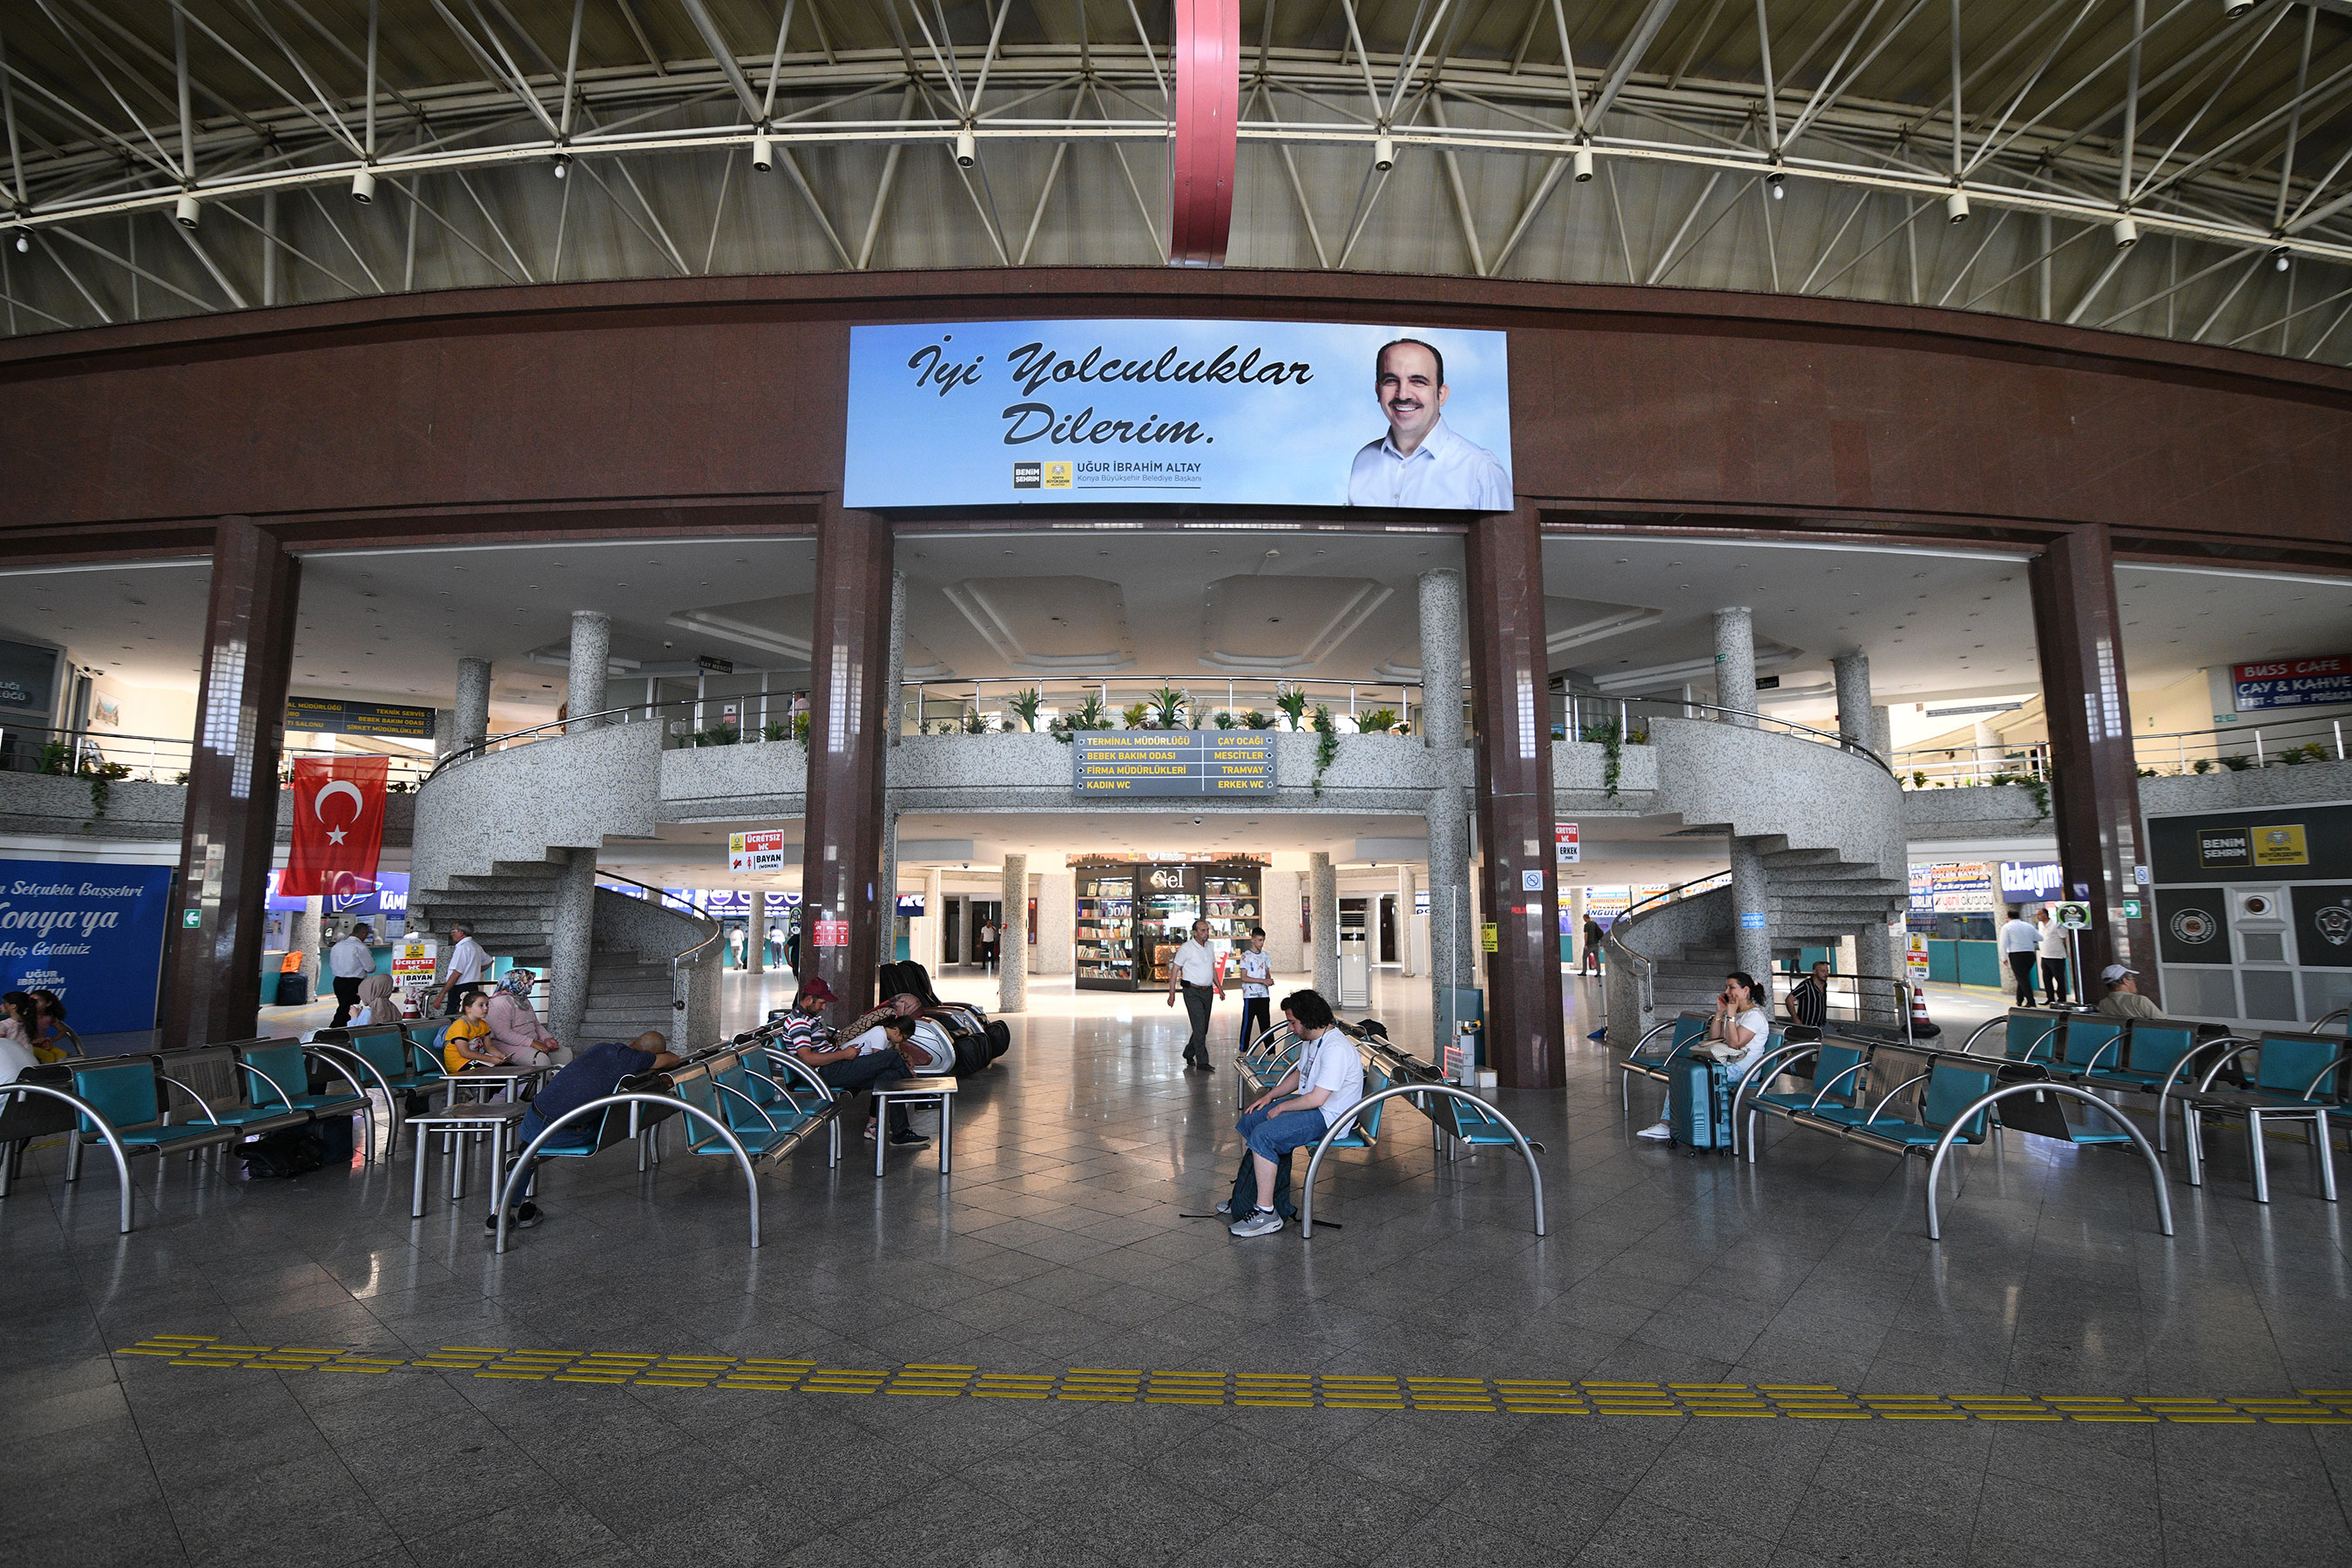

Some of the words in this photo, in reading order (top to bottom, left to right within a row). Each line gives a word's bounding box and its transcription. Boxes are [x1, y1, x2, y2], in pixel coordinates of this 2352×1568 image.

[907, 335, 984, 397] İyi
[1006, 342, 1314, 397] Yolculuklar
[1002, 402, 1213, 445] Dilerim.
[1078, 461, 1110, 472] UĞUR
[1113, 461, 1163, 472] İBRAHİM
[1166, 463, 1201, 472] ALTAY
[1101, 473, 1140, 482] Büyükşehir
[2244, 664, 2288, 678] BUSS
[2295, 659, 2342, 673] CAFE
[2238, 681, 2272, 697] ÇAY
[2275, 680, 2289, 693] &
[2292, 675, 2352, 691] KAHVE
[298, 702, 342, 711] MÜDÜRLÜĞÜ
[372, 726, 425, 735] MÜDÜRLÜKLERİ
[1087, 736, 1132, 746] TERMİNAL
[1134, 735, 1191, 746] MÜDÜRLÜĞÜ
[1218, 737, 1235, 747] ÇAY
[1236, 735, 1264, 746] OCAĞI
[1087, 752, 1117, 760] BEBEK
[1119, 752, 1147, 760] BAKIM
[1149, 752, 1176, 760] ODASI
[1214, 750, 1264, 760] MESCİTLER
[1086, 765, 1115, 774] FİRMA
[1117, 764, 1186, 774] MÜDÜRLÜKLERİ
[1222, 766, 1264, 774] TRAMVAY
[1086, 781, 1115, 789] KADIN
[1116, 781, 1131, 789] WC
[747, 833, 781, 843] ÜCRETSİZ
[2202, 838, 2246, 848] BENİM
[758, 842, 769, 851] WC
[1560, 846, 1578, 855] ERKEK
[756, 854, 781, 863] BAYAN
[10, 881, 76, 898] Selçuklu
[78, 882, 145, 899] Başşehri
[0, 942, 29, 958] Hoş
[31, 942, 91, 956] Geldiniz
[25, 970, 57, 978] UĞUR
[17, 977, 65, 986] İBRAHİM
